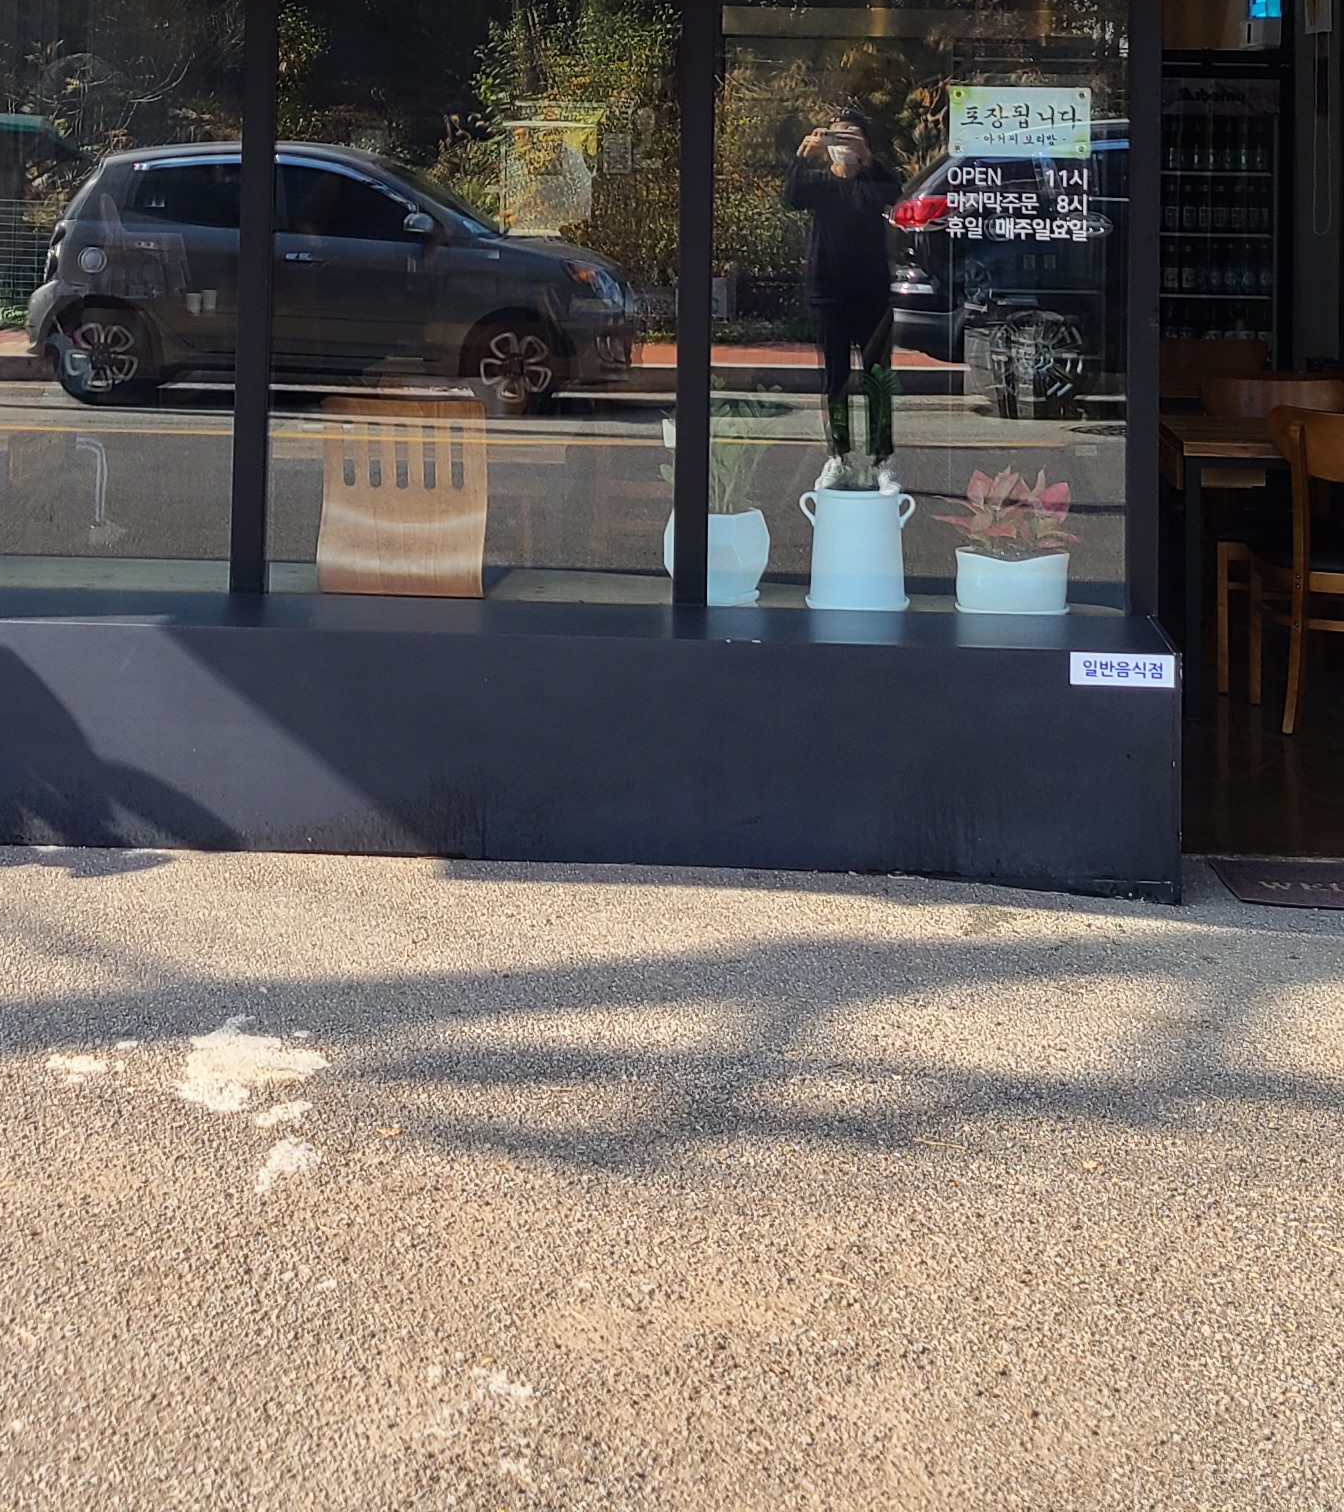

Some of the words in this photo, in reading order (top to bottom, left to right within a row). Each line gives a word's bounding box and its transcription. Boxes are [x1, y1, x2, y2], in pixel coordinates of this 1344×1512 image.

[960, 102, 1083, 130] 포장됩니다
[1023, 133, 1058, 146] 보리밥
[947, 166, 1002, 187] OPEN
[1045, 168, 1089, 191] 11시
[946, 191, 1040, 215] 마지막주문
[1056, 194, 1089, 216] 8시
[945, 215, 984, 240] 휴일
[994, 217, 1089, 242] 매주일요일
[1081, 658, 1165, 682] 일반음식점
